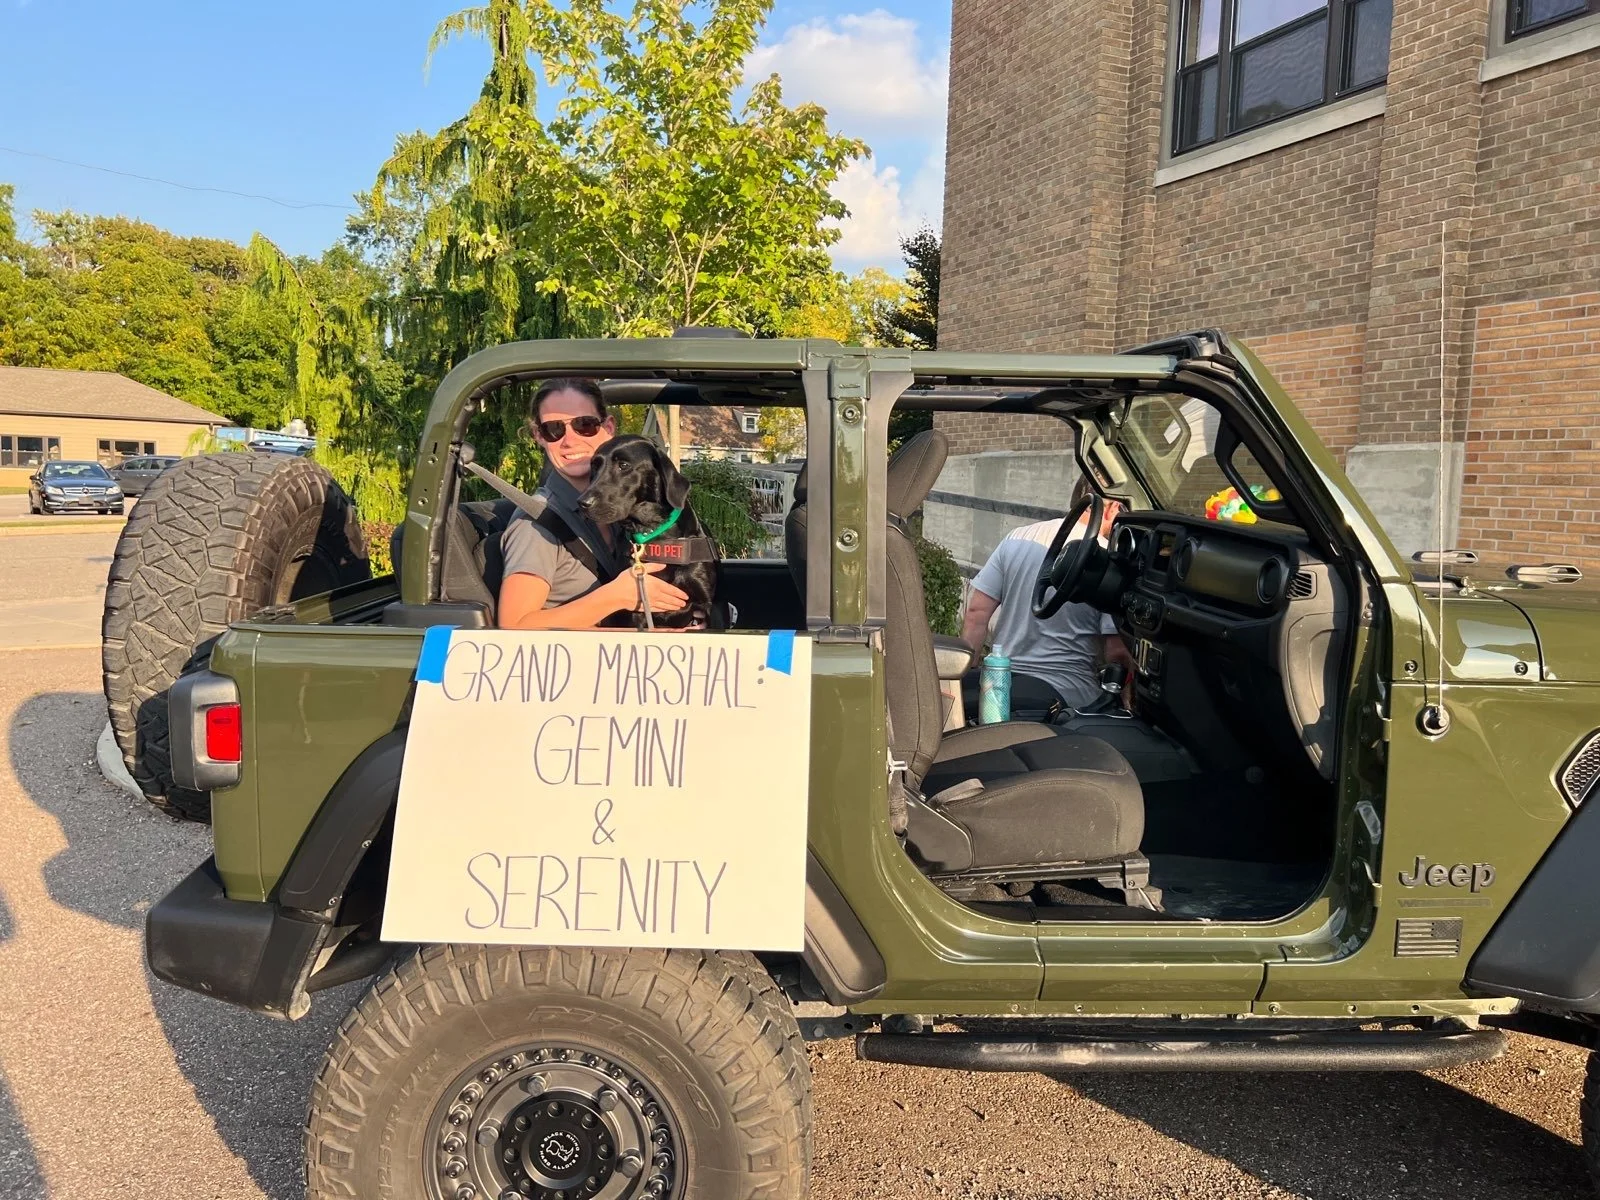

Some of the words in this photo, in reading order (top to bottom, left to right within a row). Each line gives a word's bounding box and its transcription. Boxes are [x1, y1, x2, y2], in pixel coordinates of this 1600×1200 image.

[649, 544, 661, 557] TO
[664, 544, 683, 558] PET
[441, 641, 571, 702] GRAND
[593, 643, 766, 709] MARSHAL:
[533, 715, 687, 788] GEMINI
[592, 799, 616, 845] &
[464, 853, 727, 935] SERENITY
[1398, 855, 1496, 893] Jeep
[543, 1132, 563, 1141] BLACK
